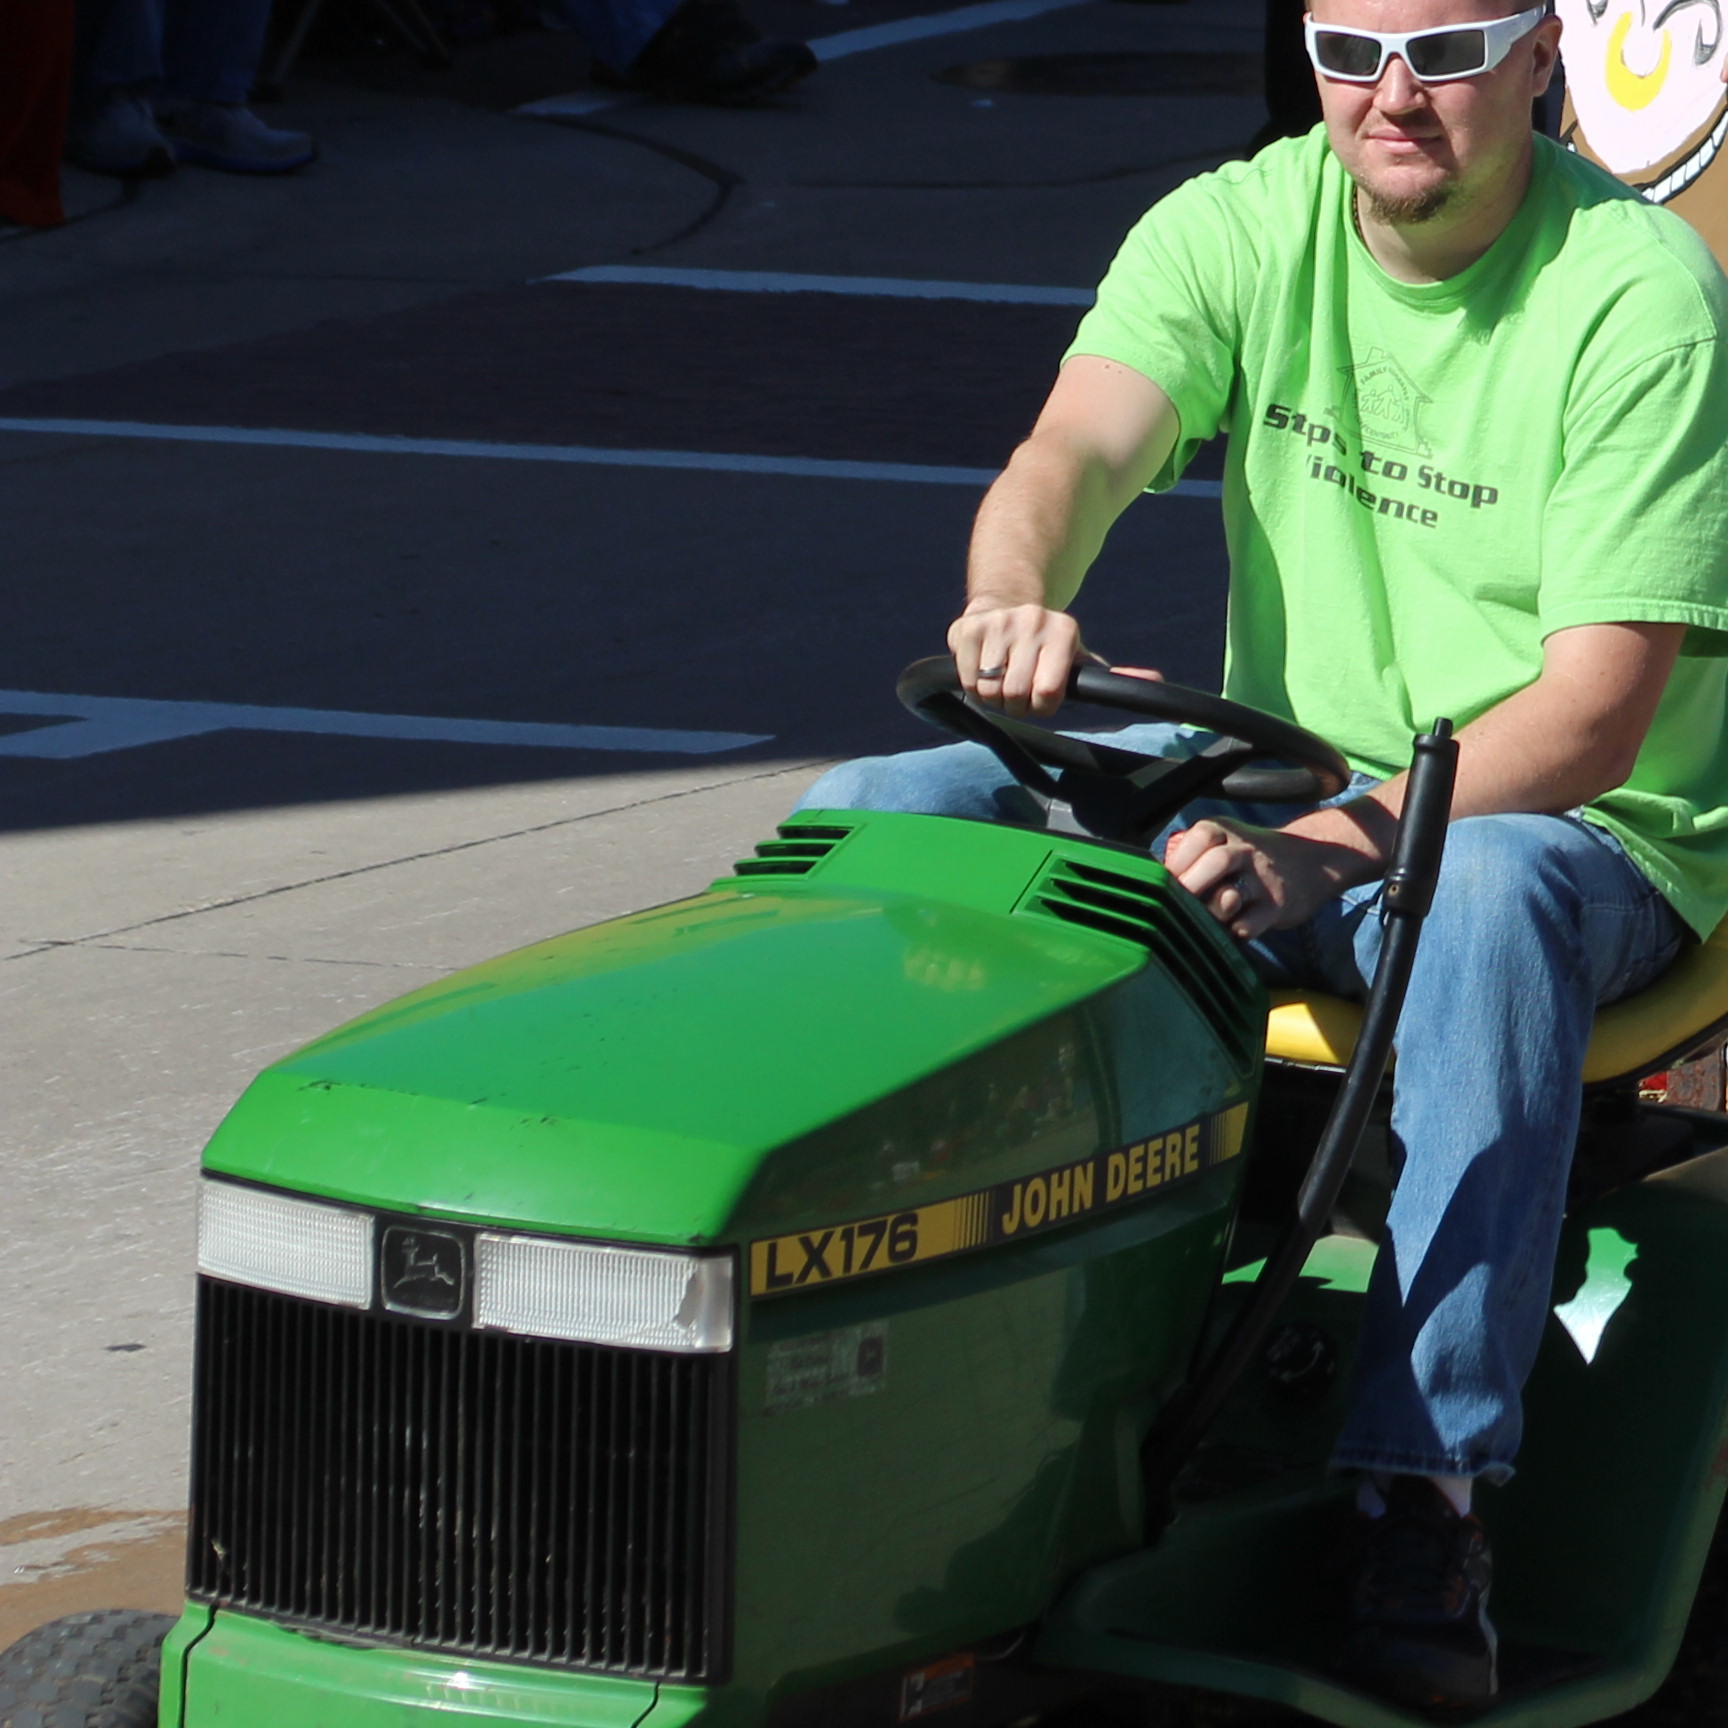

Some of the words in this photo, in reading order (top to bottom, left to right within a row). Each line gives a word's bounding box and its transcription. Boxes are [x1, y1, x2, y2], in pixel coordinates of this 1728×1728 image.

[1262, 402, 1348, 456] Stps
[1360, 449, 1409, 482] to
[1416, 463, 1500, 510] Stop
[1306, 453, 1439, 528] iolence
[765, 1212, 919, 1290] LX176
[1001, 1161, 1095, 1236] JOHN
[1105, 1123, 1200, 1204] DEERE
